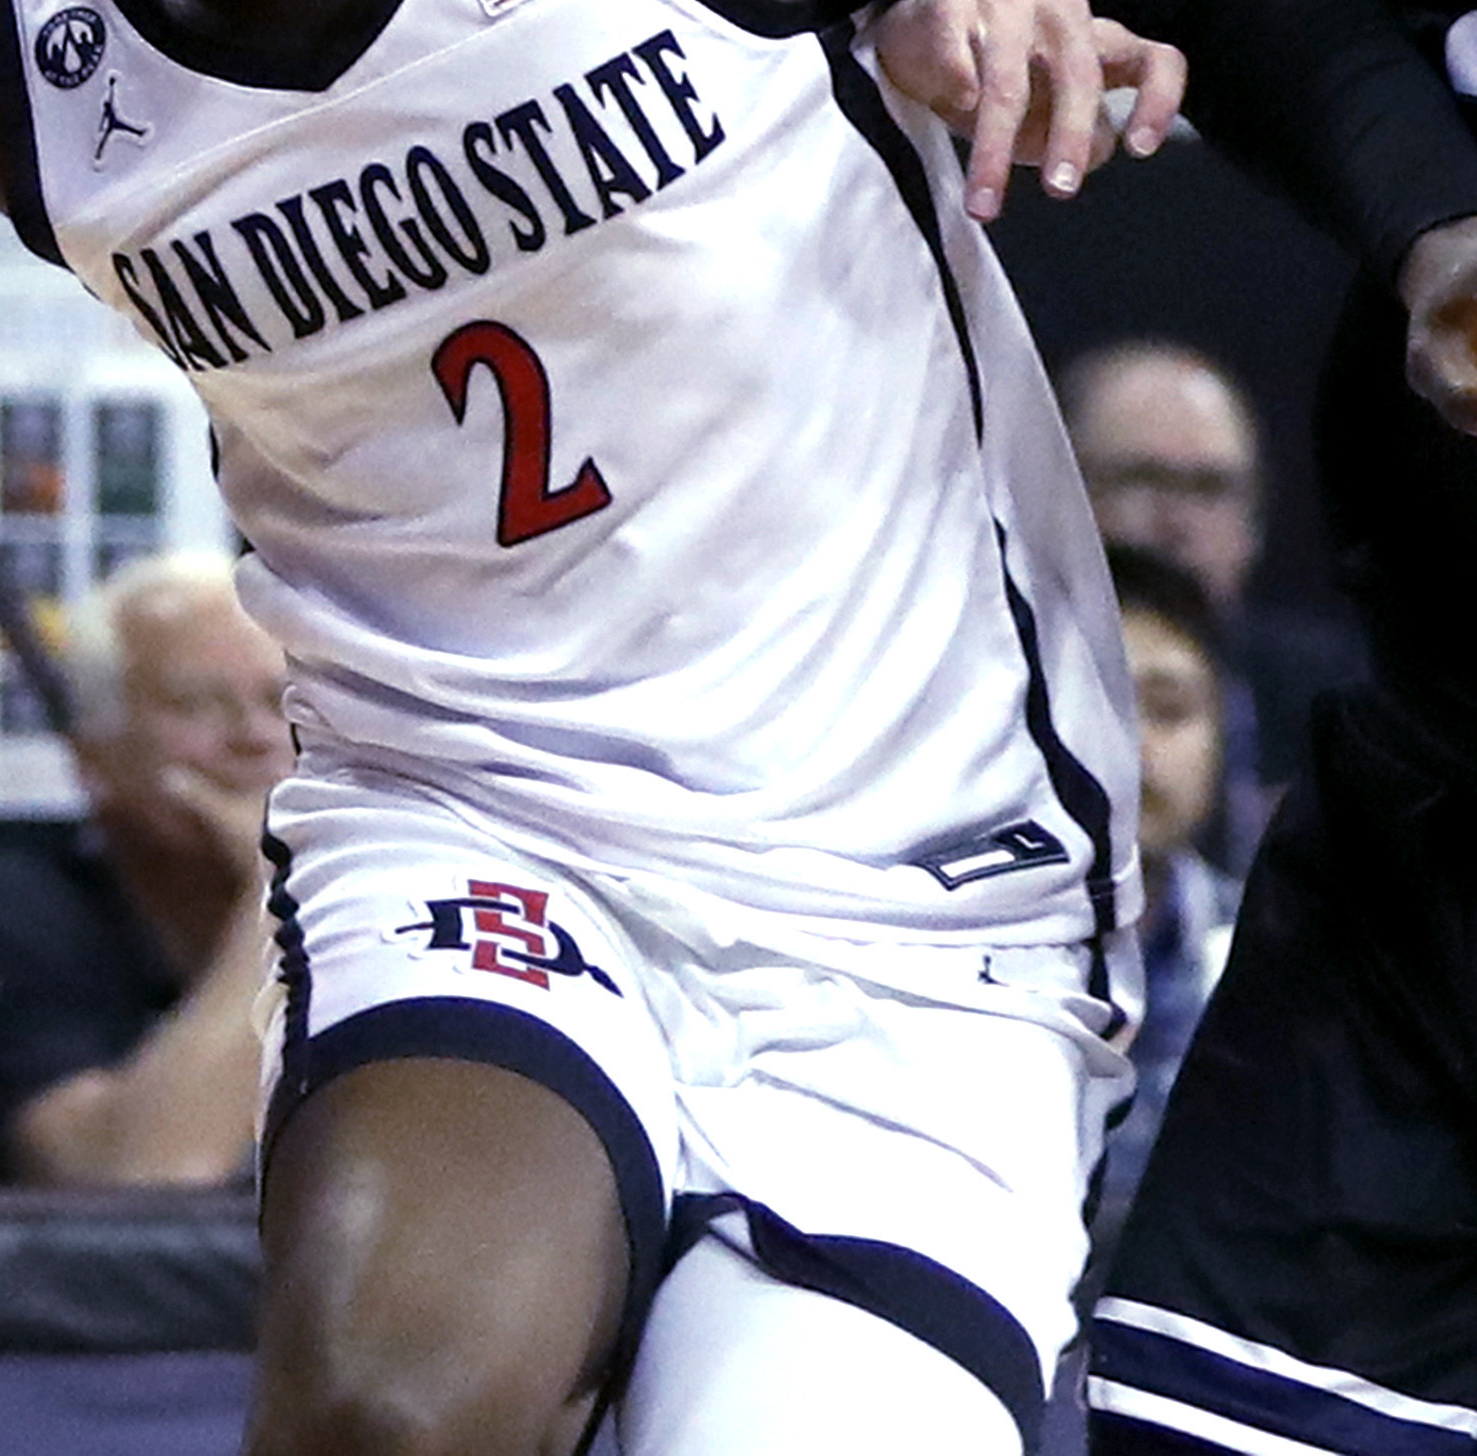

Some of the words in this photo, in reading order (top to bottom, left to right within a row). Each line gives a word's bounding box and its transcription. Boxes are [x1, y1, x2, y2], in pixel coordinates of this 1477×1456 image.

[111, 229, 273, 373] SAN
[230, 144, 492, 340] DIEGO
[461, 28, 727, 253] STATE
[430, 319, 613, 549] 2
